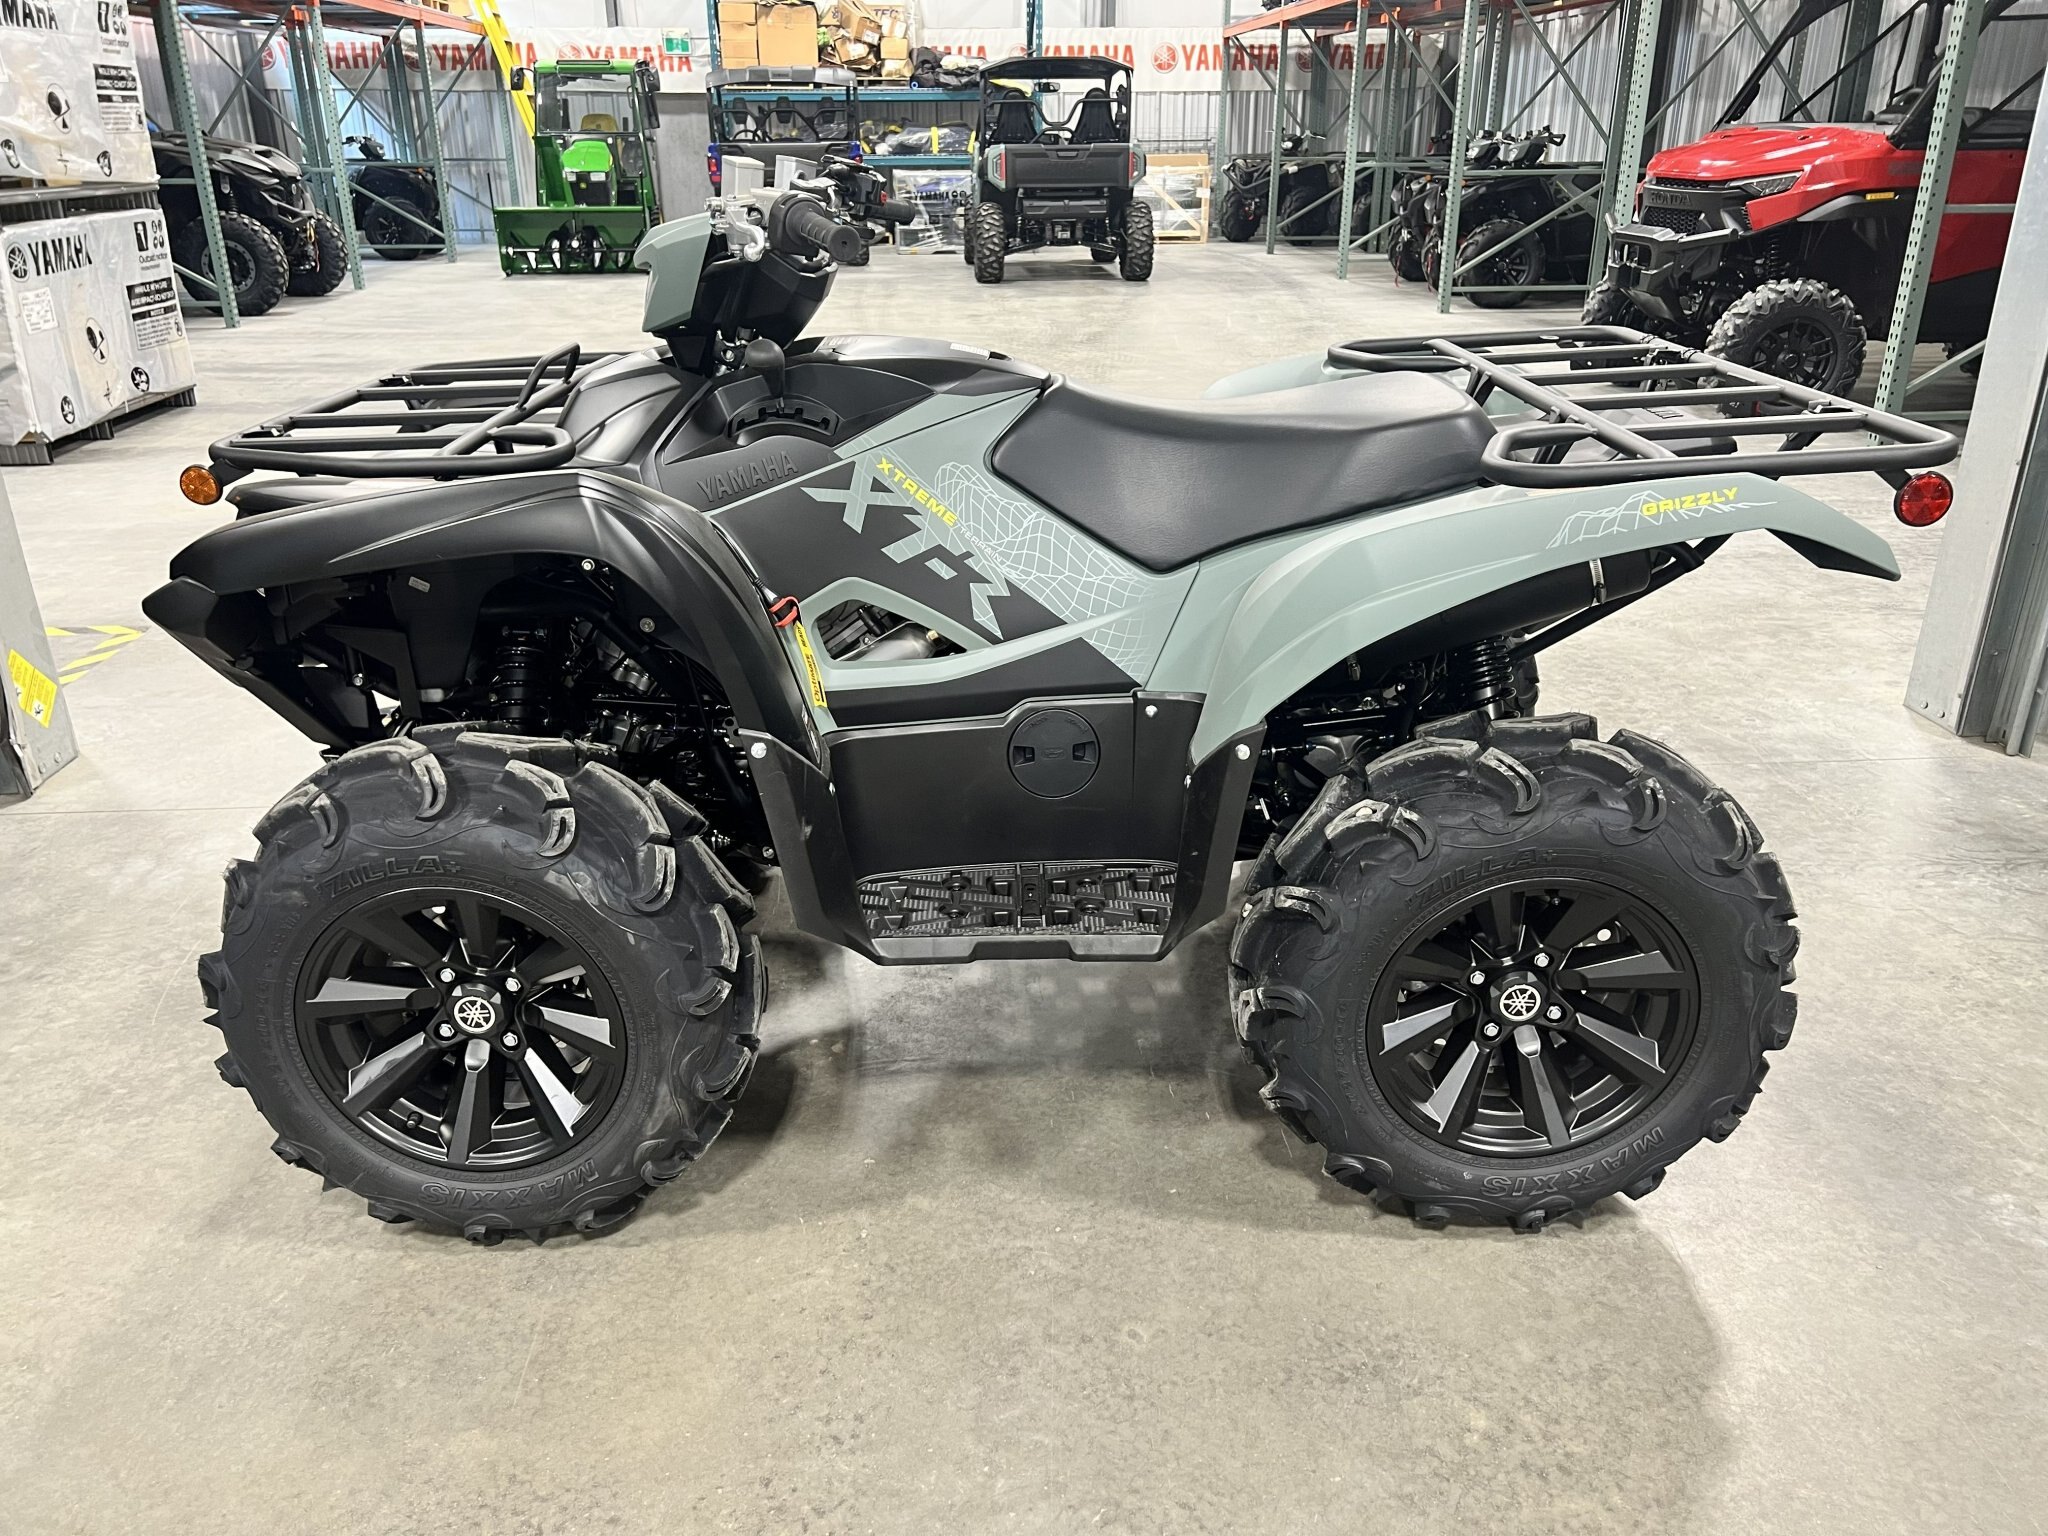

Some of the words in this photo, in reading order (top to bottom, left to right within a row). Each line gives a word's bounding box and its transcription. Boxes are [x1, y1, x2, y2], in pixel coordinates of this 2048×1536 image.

[0, 0, 59, 30] MAHA
[1649, 190, 1692, 208] HONDA
[27, 233, 93, 277] YAMAHA
[696, 450, 799, 503] YAMAHA
[875, 457, 958, 527] XTREME
[959, 525, 1004, 564] TERRAIN
[1641, 486, 1739, 516] GRIZZLY
[419, 1158, 600, 1210] MAXXIS
[1481, 1126, 1666, 1198] MAXXIS
